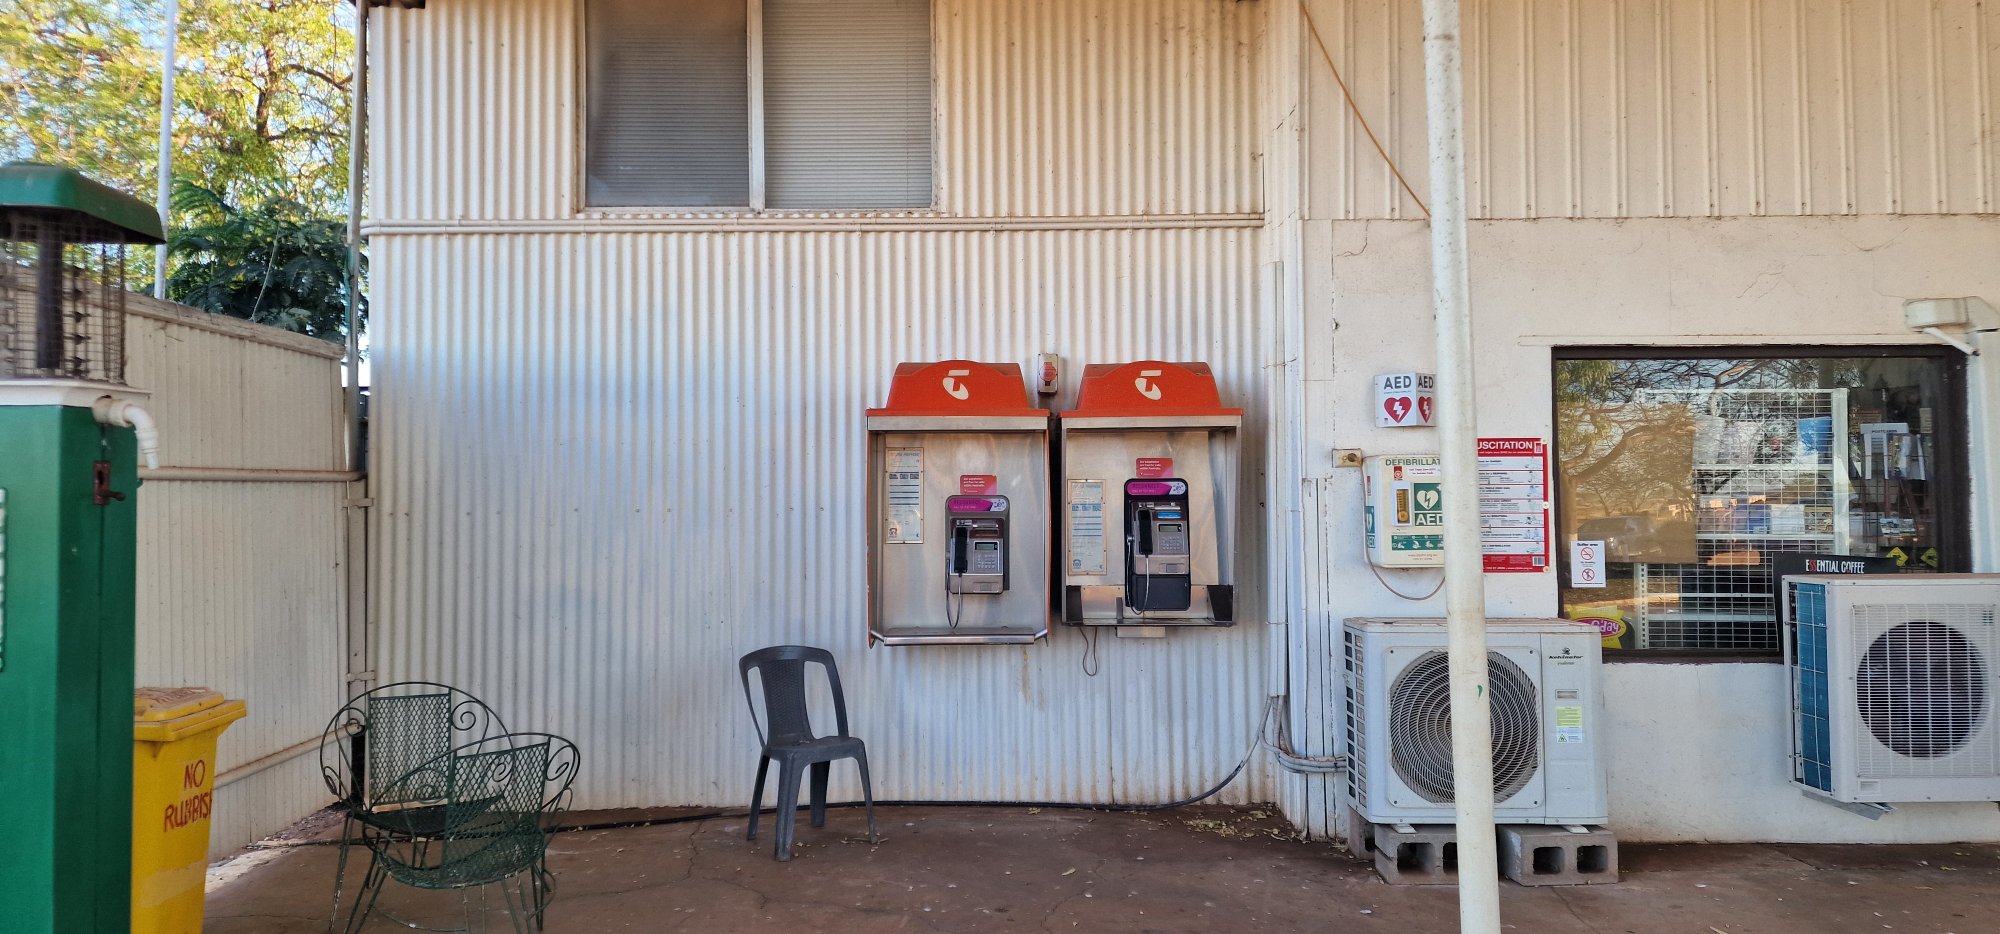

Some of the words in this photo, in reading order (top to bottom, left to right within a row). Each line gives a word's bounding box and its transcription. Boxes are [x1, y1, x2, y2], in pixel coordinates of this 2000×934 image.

[1383, 375, 1412, 390] AED
[1417, 375, 1434, 389] AED
[1415, 513, 1444, 526] AED
[1805, 559, 1840, 573] ESSENTIAL
[1841, 560, 1865, 574] COFFEE
[184, 759, 206, 791] NO
